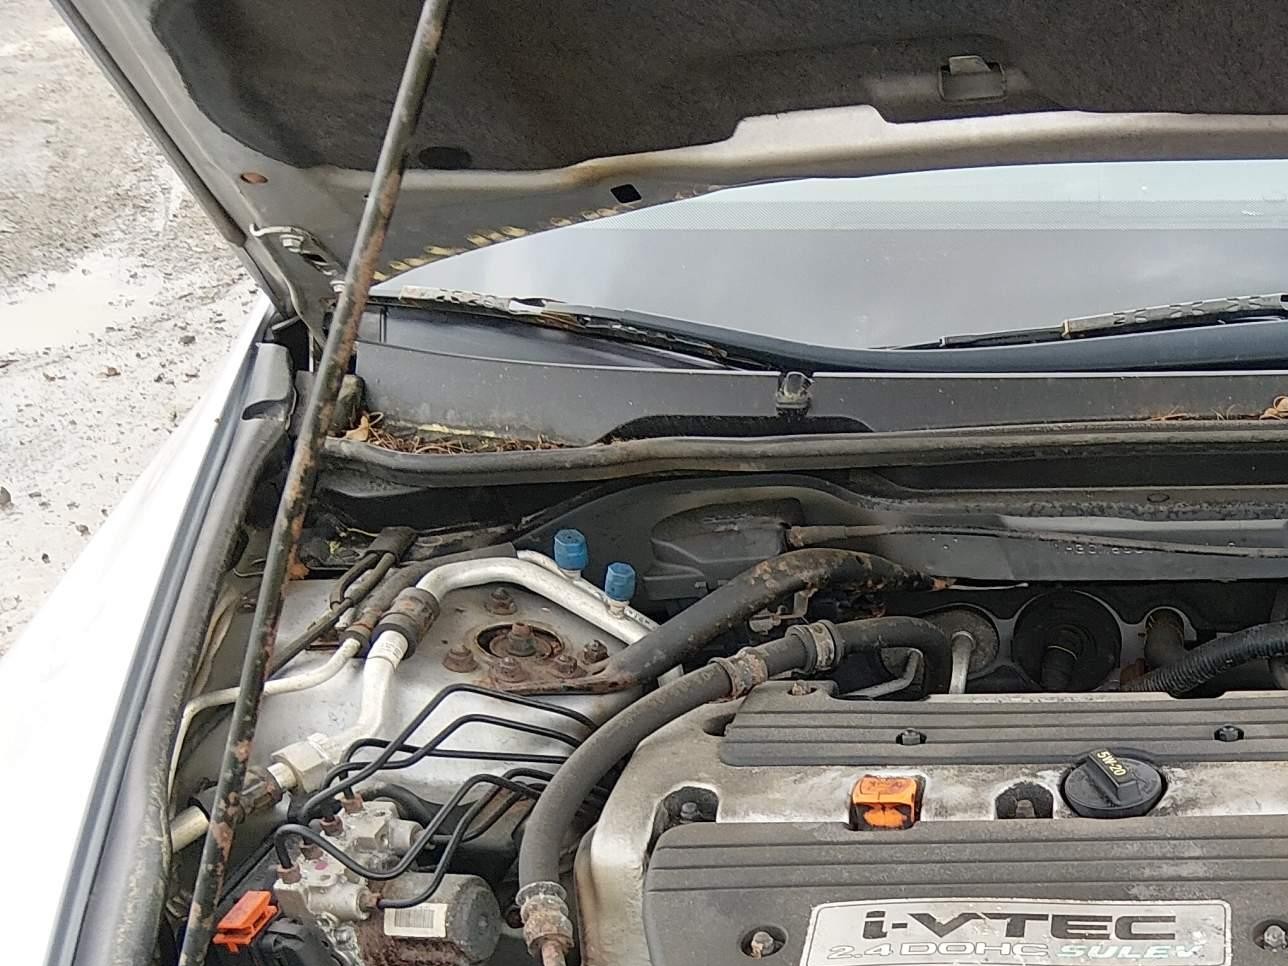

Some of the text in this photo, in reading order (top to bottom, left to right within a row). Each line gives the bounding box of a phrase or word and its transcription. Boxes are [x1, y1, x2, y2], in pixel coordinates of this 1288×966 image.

[1097, 751, 1127, 776] 5W-20
[862, 910, 1176, 941] i-VTEC
[827, 941, 1202, 960] 2.4 DOHC SULEV
